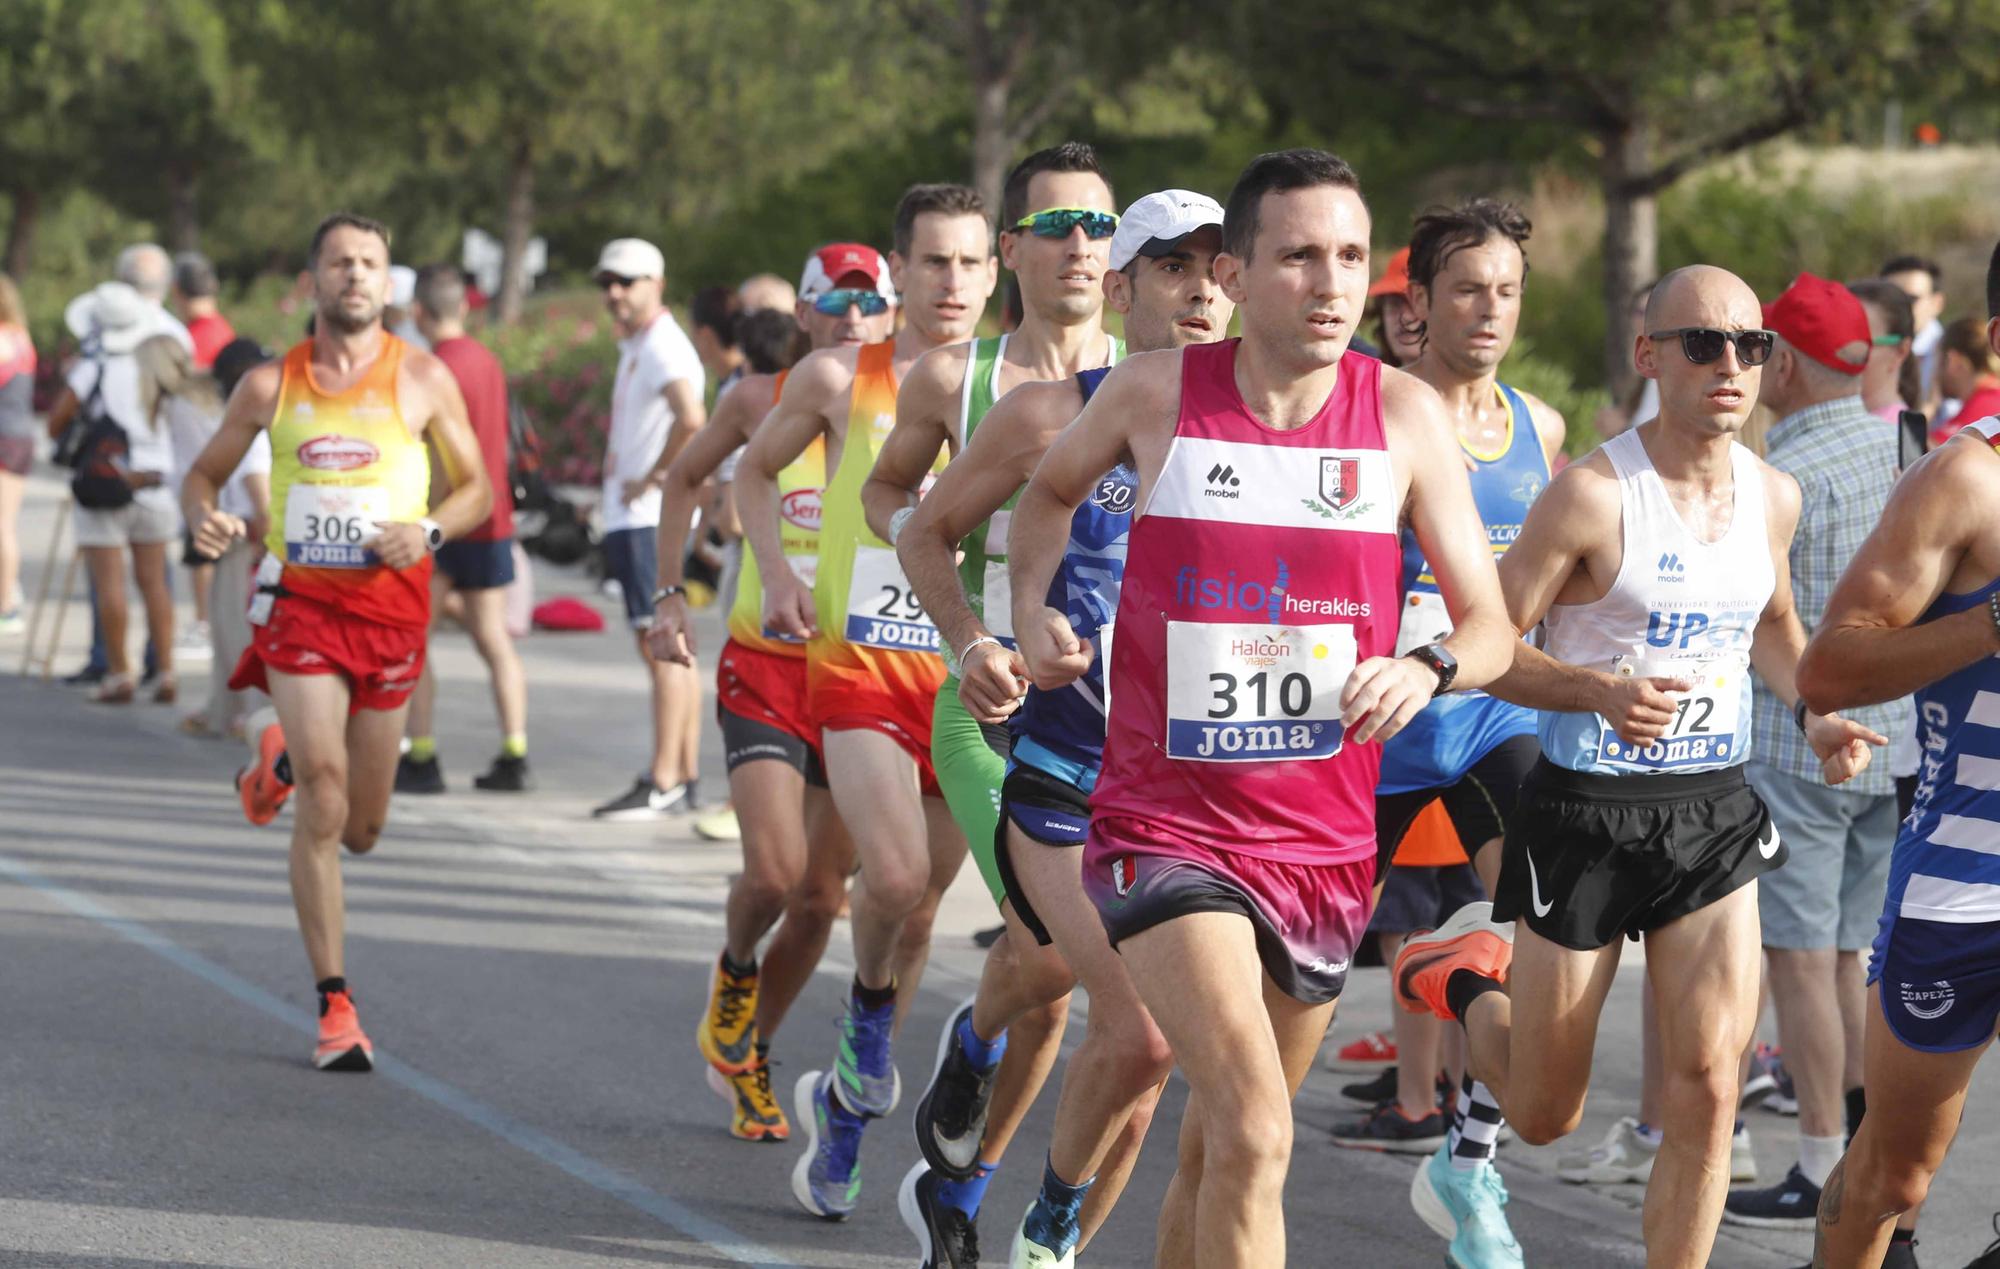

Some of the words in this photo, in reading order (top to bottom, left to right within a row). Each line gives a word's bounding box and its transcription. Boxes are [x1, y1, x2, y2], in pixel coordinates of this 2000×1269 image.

[1325, 463, 1354, 474] CABC
[1091, 480, 1131, 505] 30
[1204, 487, 1240, 499] mobel
[304, 514, 363, 543] 306
[1658, 574, 1685, 584] mobel
[1175, 566, 1266, 612] fisio
[1285, 594, 1371, 617] herakles
[1646, 611, 1756, 649] UPCT
[1244, 656, 1277, 669] viajes
[1208, 671, 1312, 719] 310
[1907, 990, 1946, 1001] CAPEX
